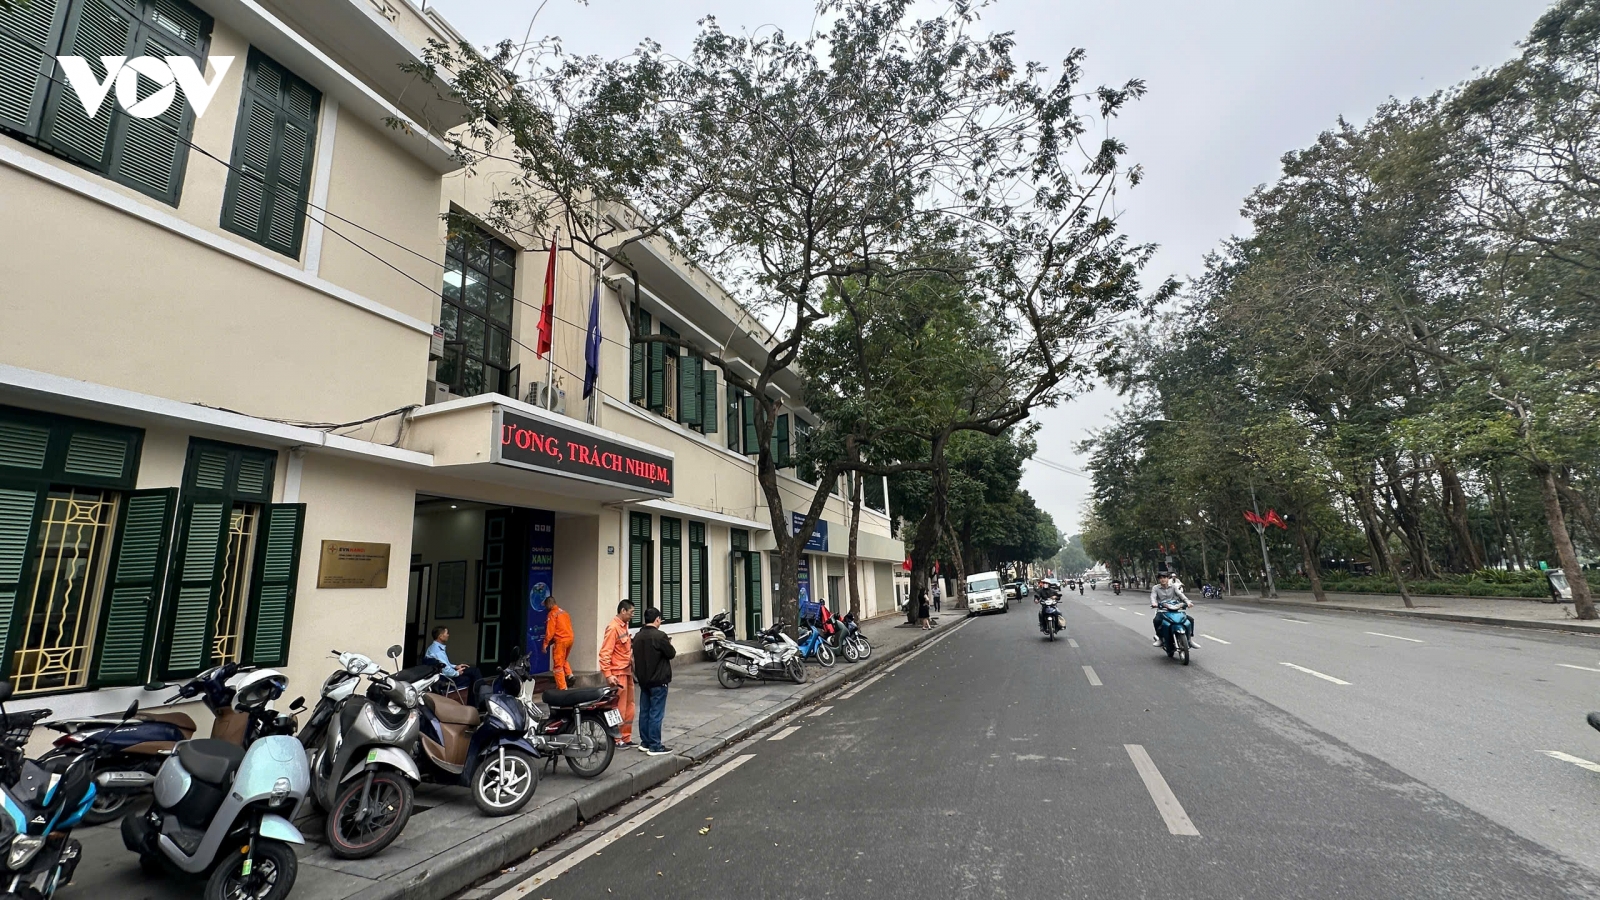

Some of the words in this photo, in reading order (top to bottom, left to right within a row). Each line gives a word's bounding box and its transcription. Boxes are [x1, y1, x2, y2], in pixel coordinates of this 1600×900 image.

[567, 442, 623, 472] TRÁCH
[625, 457, 670, 485] NHIỆM,
[532, 554, 552, 564] XANH
